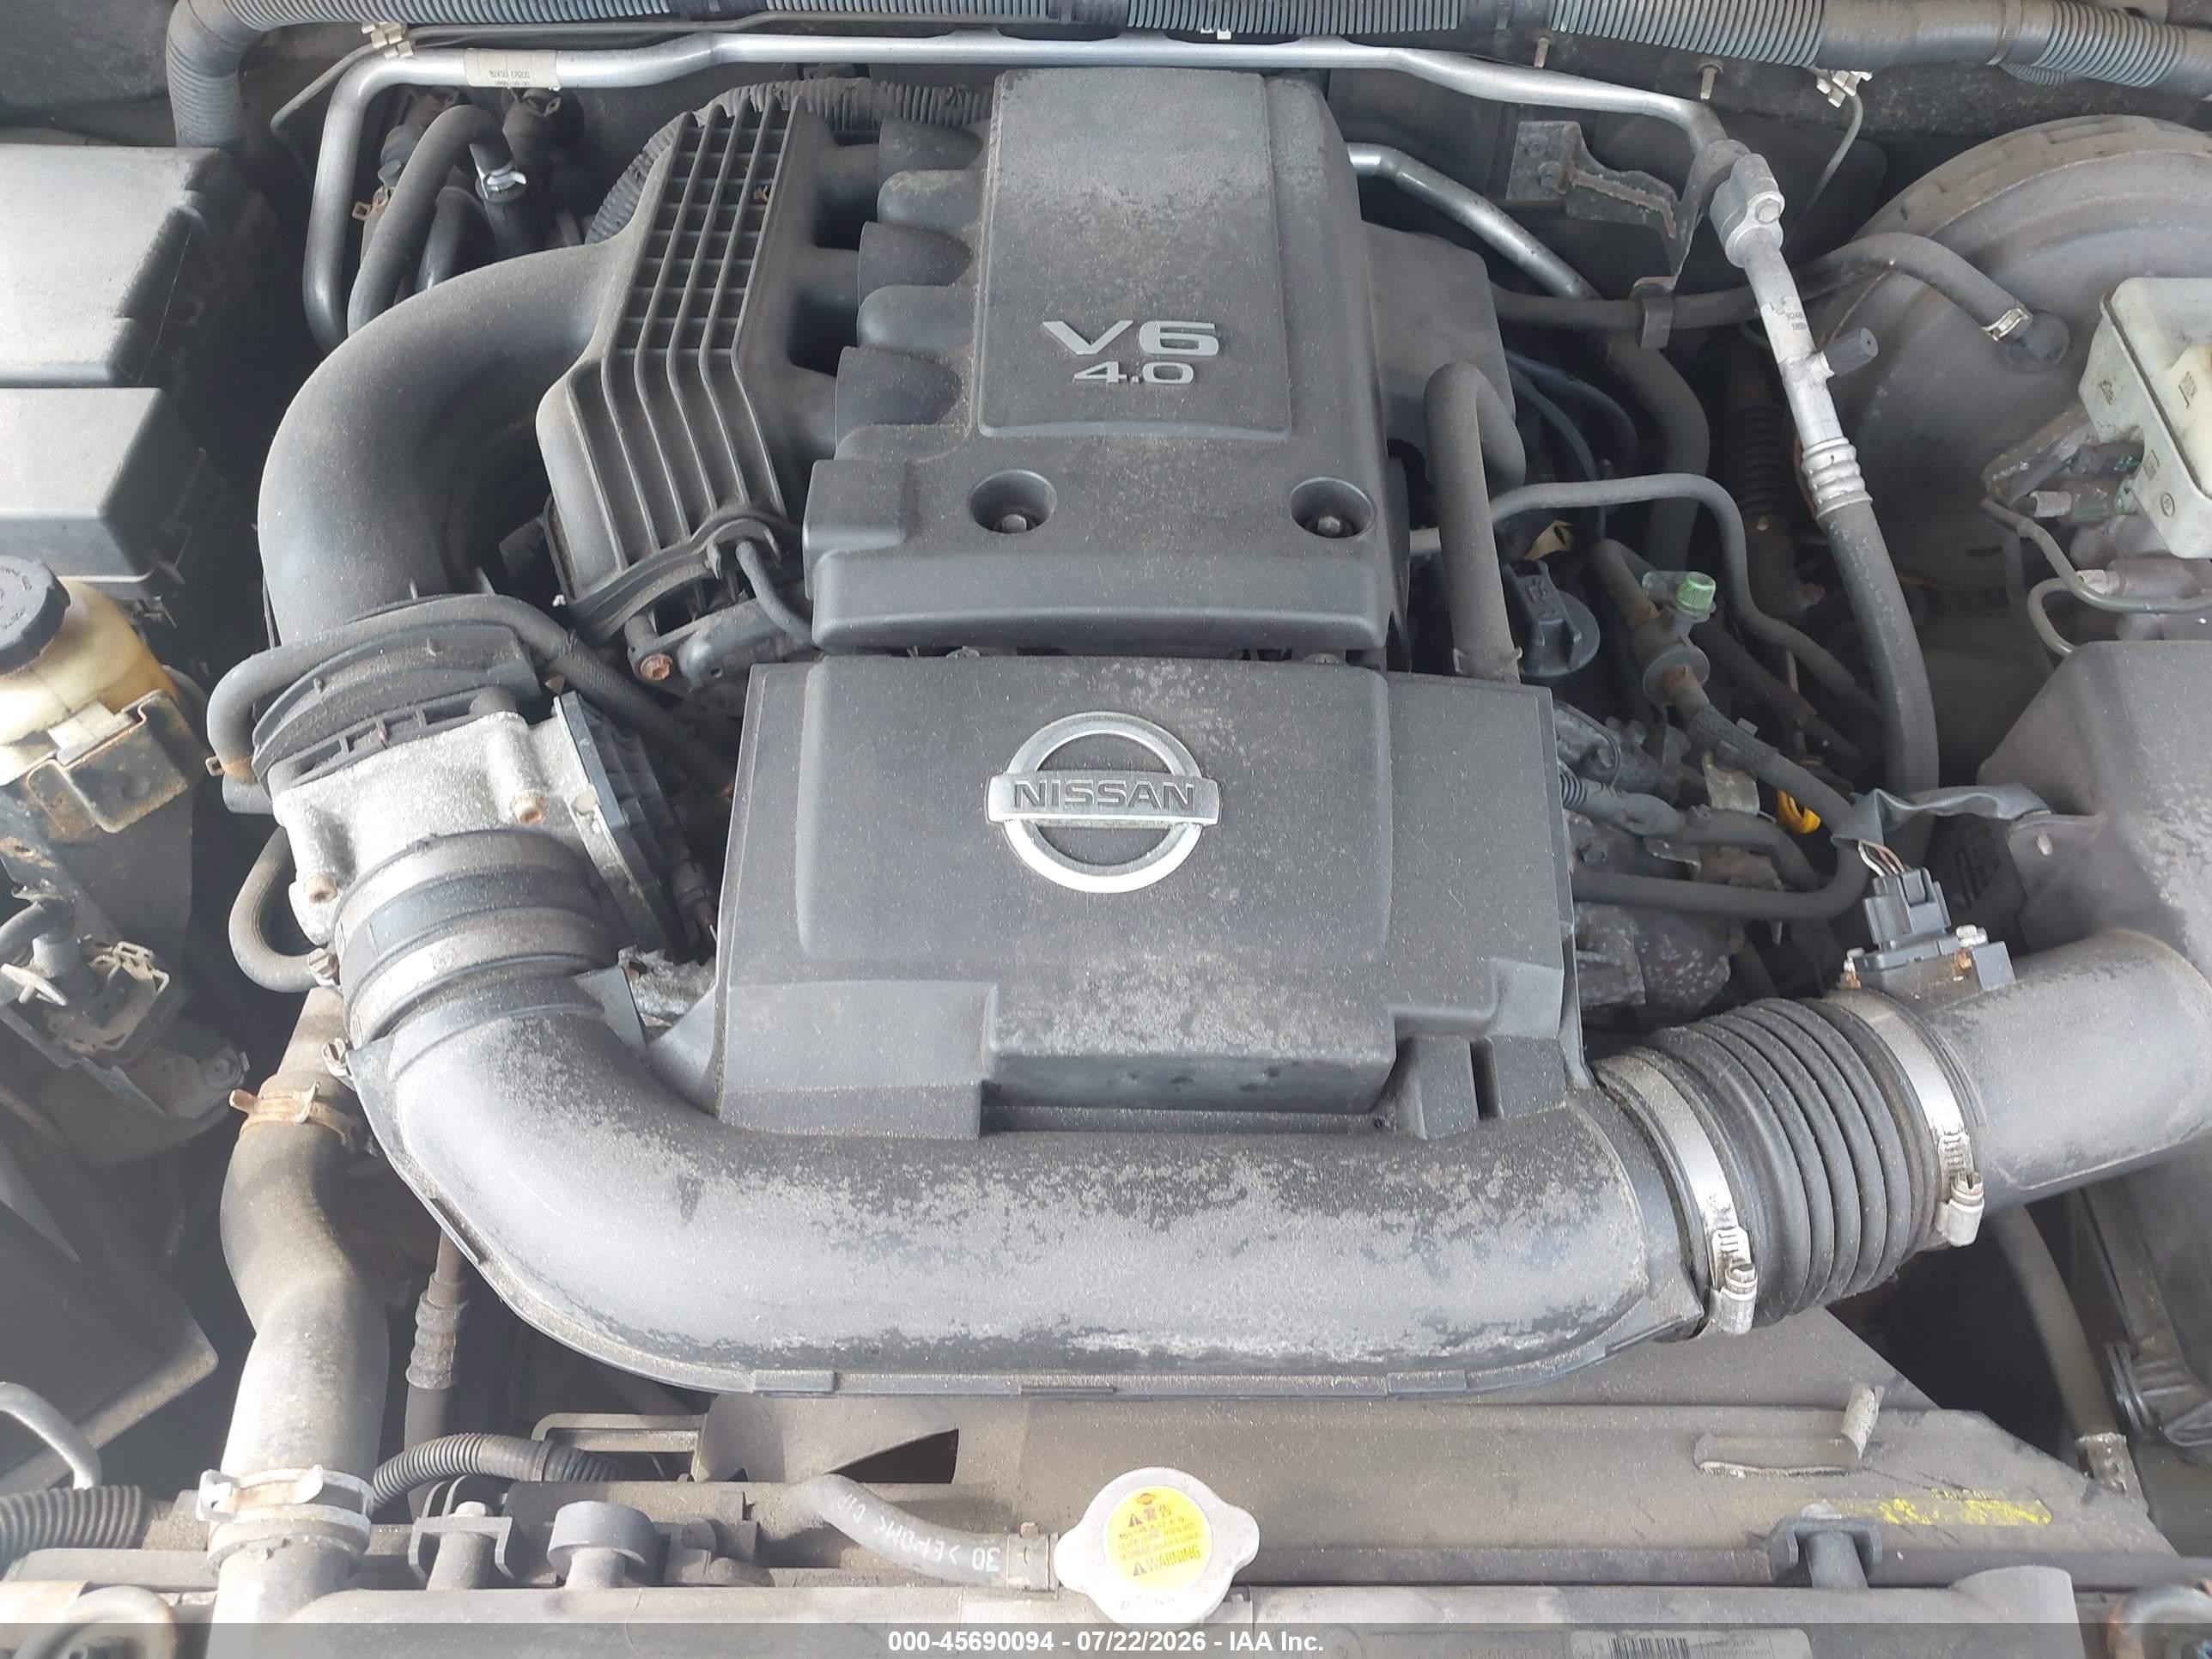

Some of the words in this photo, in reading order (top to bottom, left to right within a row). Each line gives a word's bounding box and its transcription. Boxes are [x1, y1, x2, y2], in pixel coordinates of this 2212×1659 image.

[1042, 319, 1219, 356] V6
[1073, 361, 1194, 384] 4.0
[1014, 779, 1194, 811] NISSAN
[1146, 1544, 1200, 1572] WARNING
